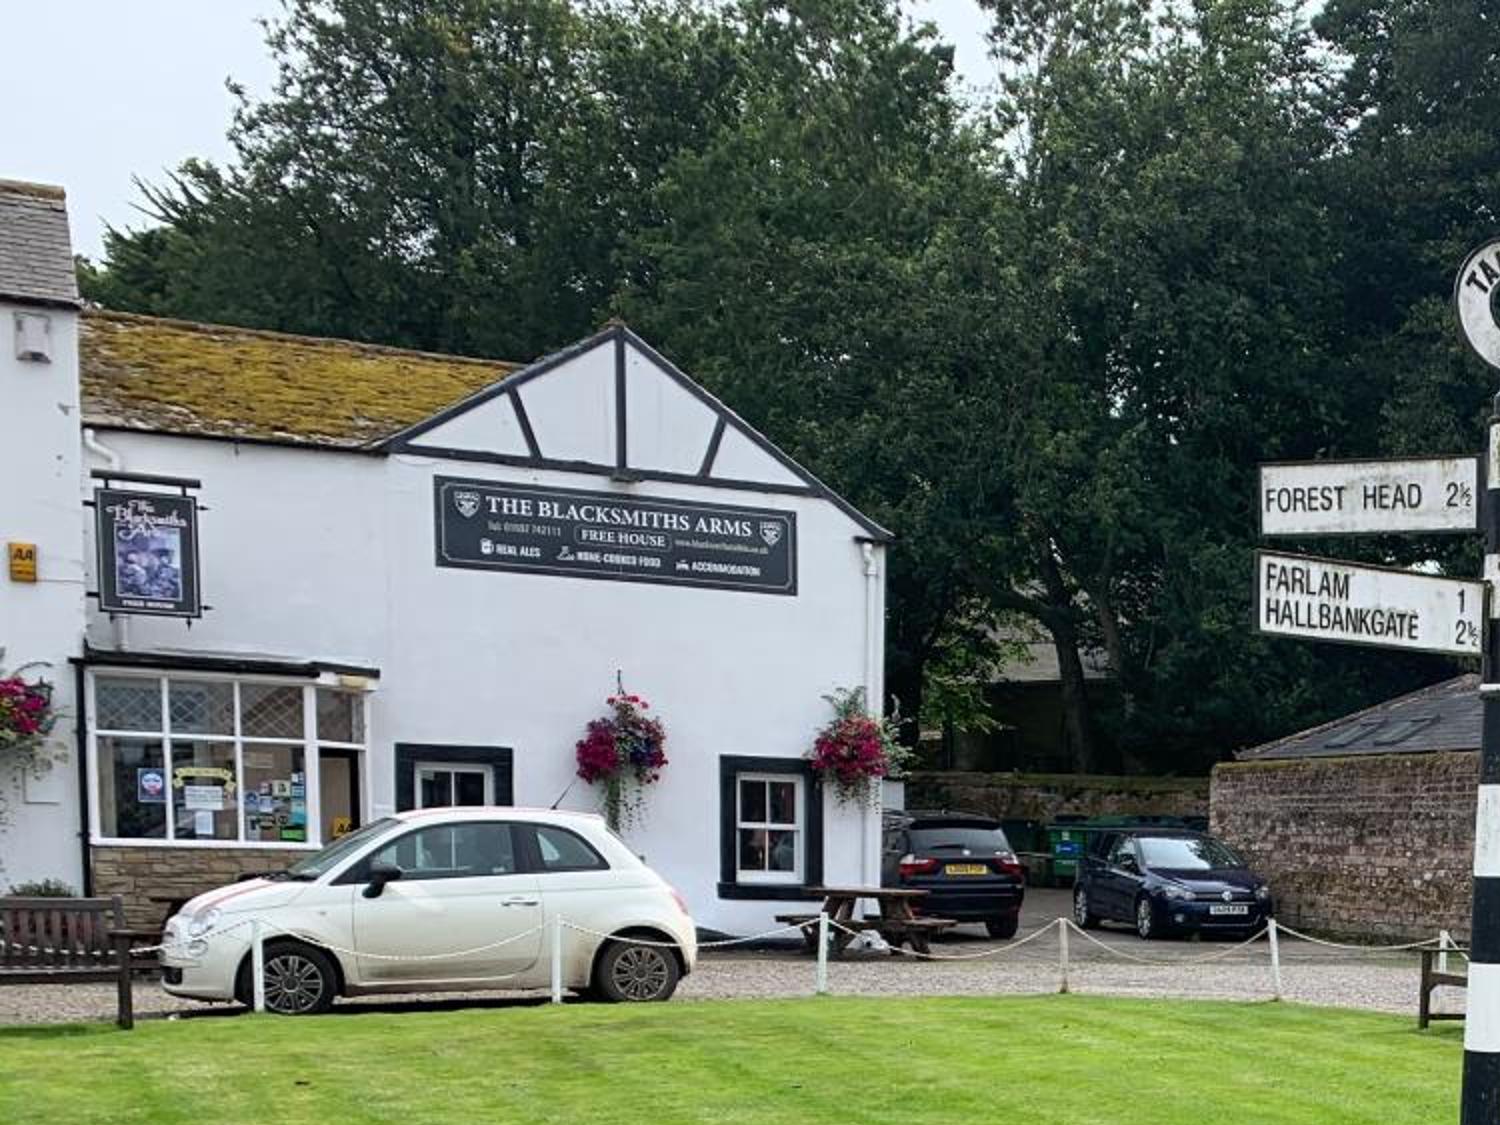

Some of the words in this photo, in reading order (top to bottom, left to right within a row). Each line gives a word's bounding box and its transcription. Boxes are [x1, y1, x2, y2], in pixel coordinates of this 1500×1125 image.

[485, 495, 533, 517] THE
[538, 500, 690, 531] BLACKSMITHS
[695, 517, 753, 537] ARMS
[1265, 485, 1345, 513] FOREST
[1363, 483, 1422, 510] HEAD
[13, 547, 33, 561] AA
[581, 529, 615, 543] FREE
[619, 532, 666, 547] HOUSE
[1266, 562, 1349, 600] FARLAM
[1457, 588, 1466, 613] 1
[1265, 598, 1419, 640] HALLBANKGATE
